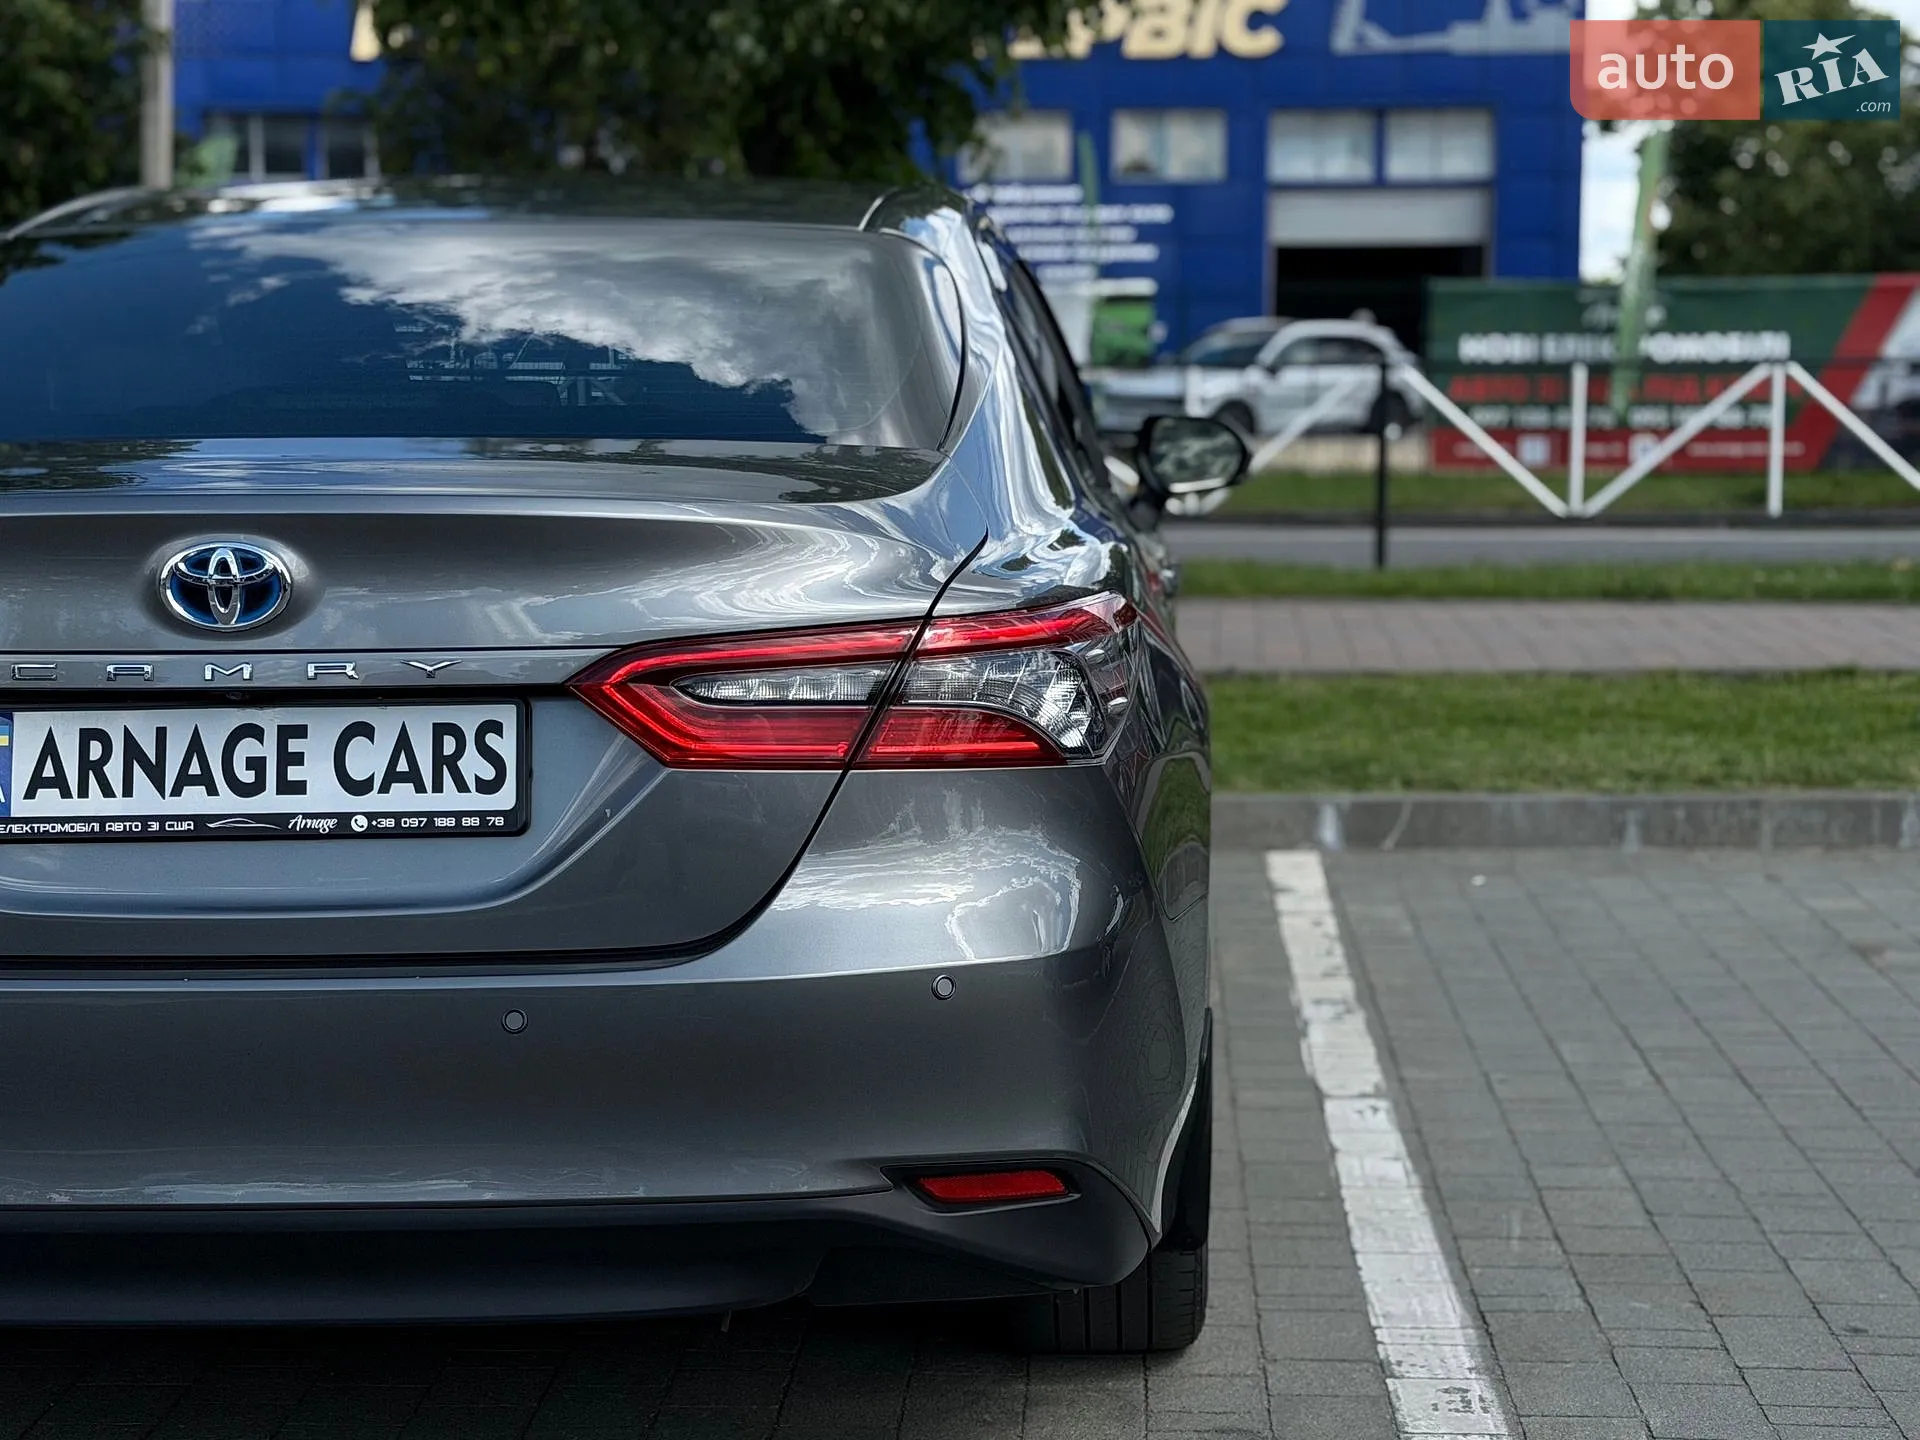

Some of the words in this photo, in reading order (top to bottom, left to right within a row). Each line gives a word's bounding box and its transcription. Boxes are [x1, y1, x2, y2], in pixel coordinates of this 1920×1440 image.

[11, 658, 463, 682] CAMRY
[22, 723, 309, 801] ARNAGE
[333, 719, 508, 798] CARS
[105, 822, 142, 832] АВТО
[165, 821, 195, 831] США
[288, 814, 338, 834] Arnage
[371, 818, 395, 828] +38
[401, 818, 428, 828] 097
[433, 817, 456, 827] 188
[461, 817, 480, 827] 88
[486, 816, 505, 826] 78
